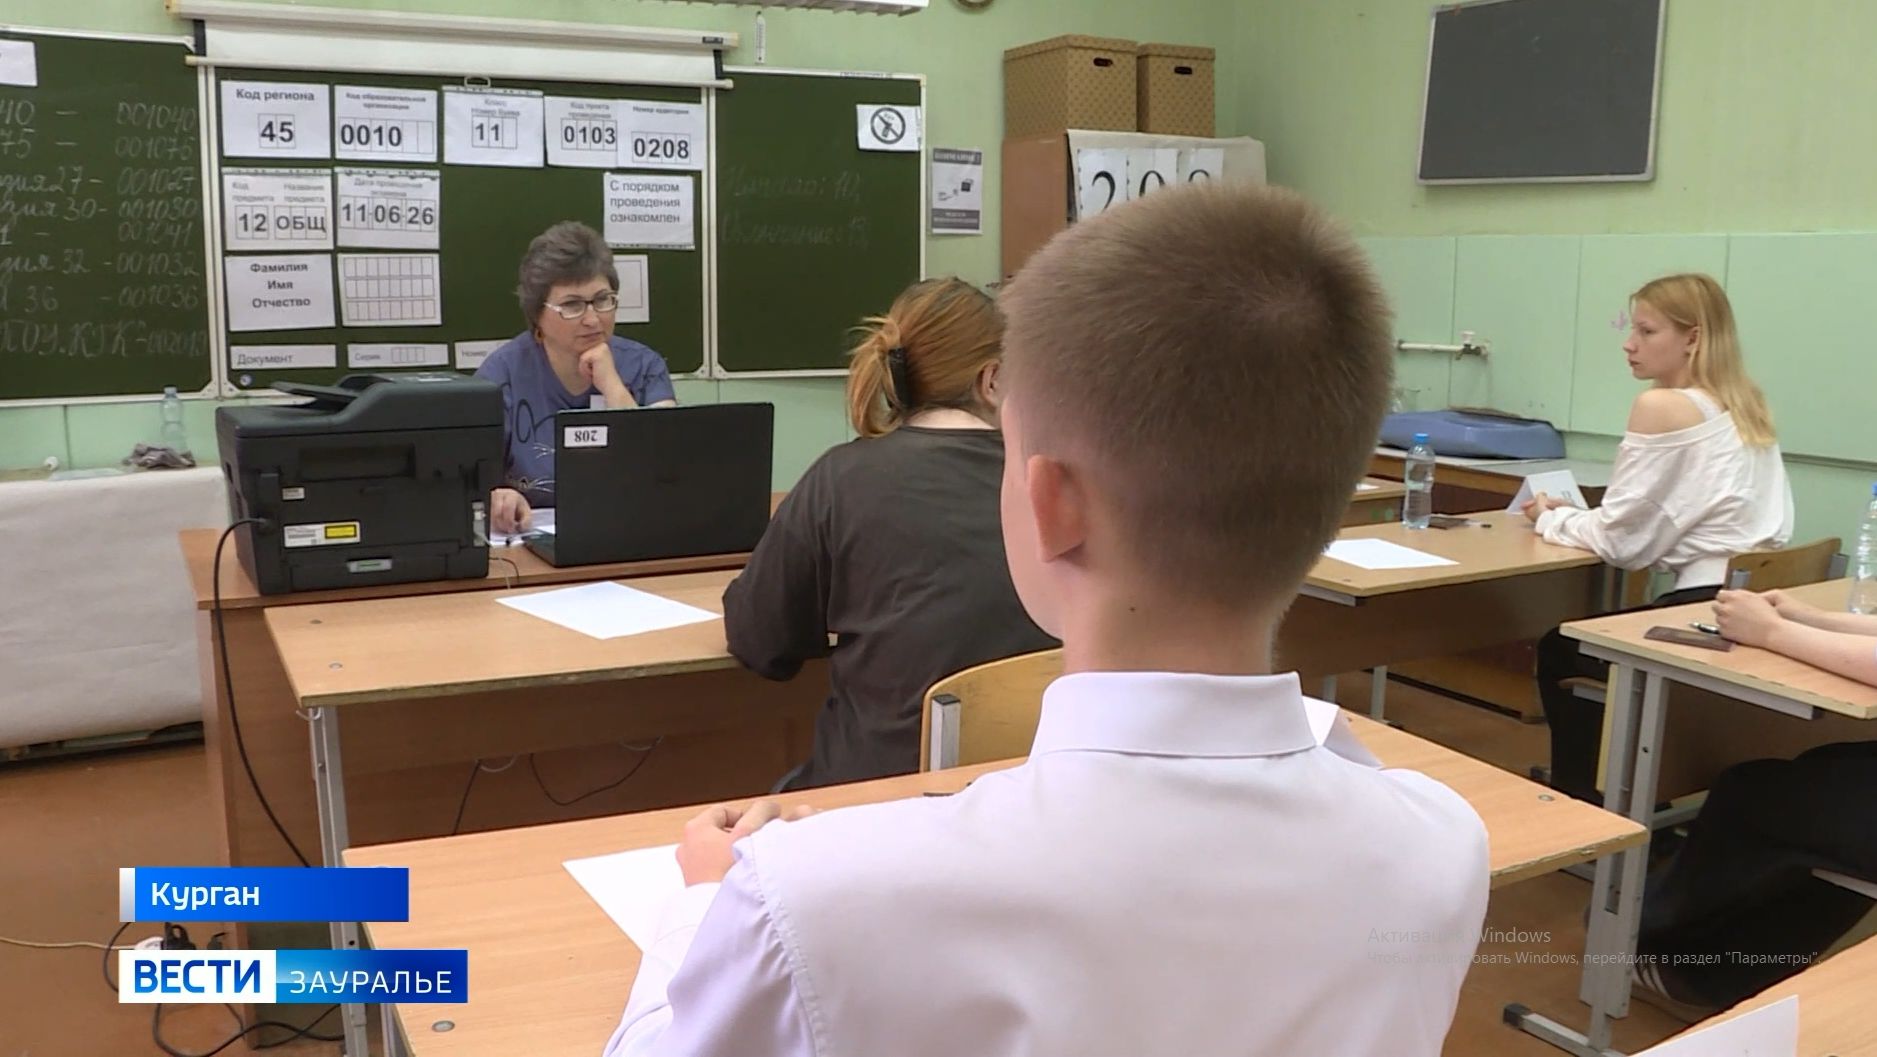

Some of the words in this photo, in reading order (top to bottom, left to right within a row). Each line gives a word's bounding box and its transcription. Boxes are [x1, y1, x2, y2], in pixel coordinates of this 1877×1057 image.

[236, 88, 260, 101] Код
[264, 90, 315, 103] региона
[260, 120, 294, 143] 45
[340, 123, 402, 147] 0010
[475, 123, 501, 142] 11
[563, 124, 616, 145] 0103
[633, 137, 690, 160] 0208
[610, 180, 620, 192] С
[622, 181, 680, 194] порядком
[610, 196, 681, 210] проведения
[239, 213, 268, 232] 12
[276, 215, 327, 234] ОБЩ
[610, 212, 681, 224] ознакомлен
[250, 261, 309, 274] Фамилия
[267, 280, 293, 291] Имя
[252, 297, 311, 309] Отчество
[237, 353, 293, 366] Документ
[574, 429, 598, 443] 208
